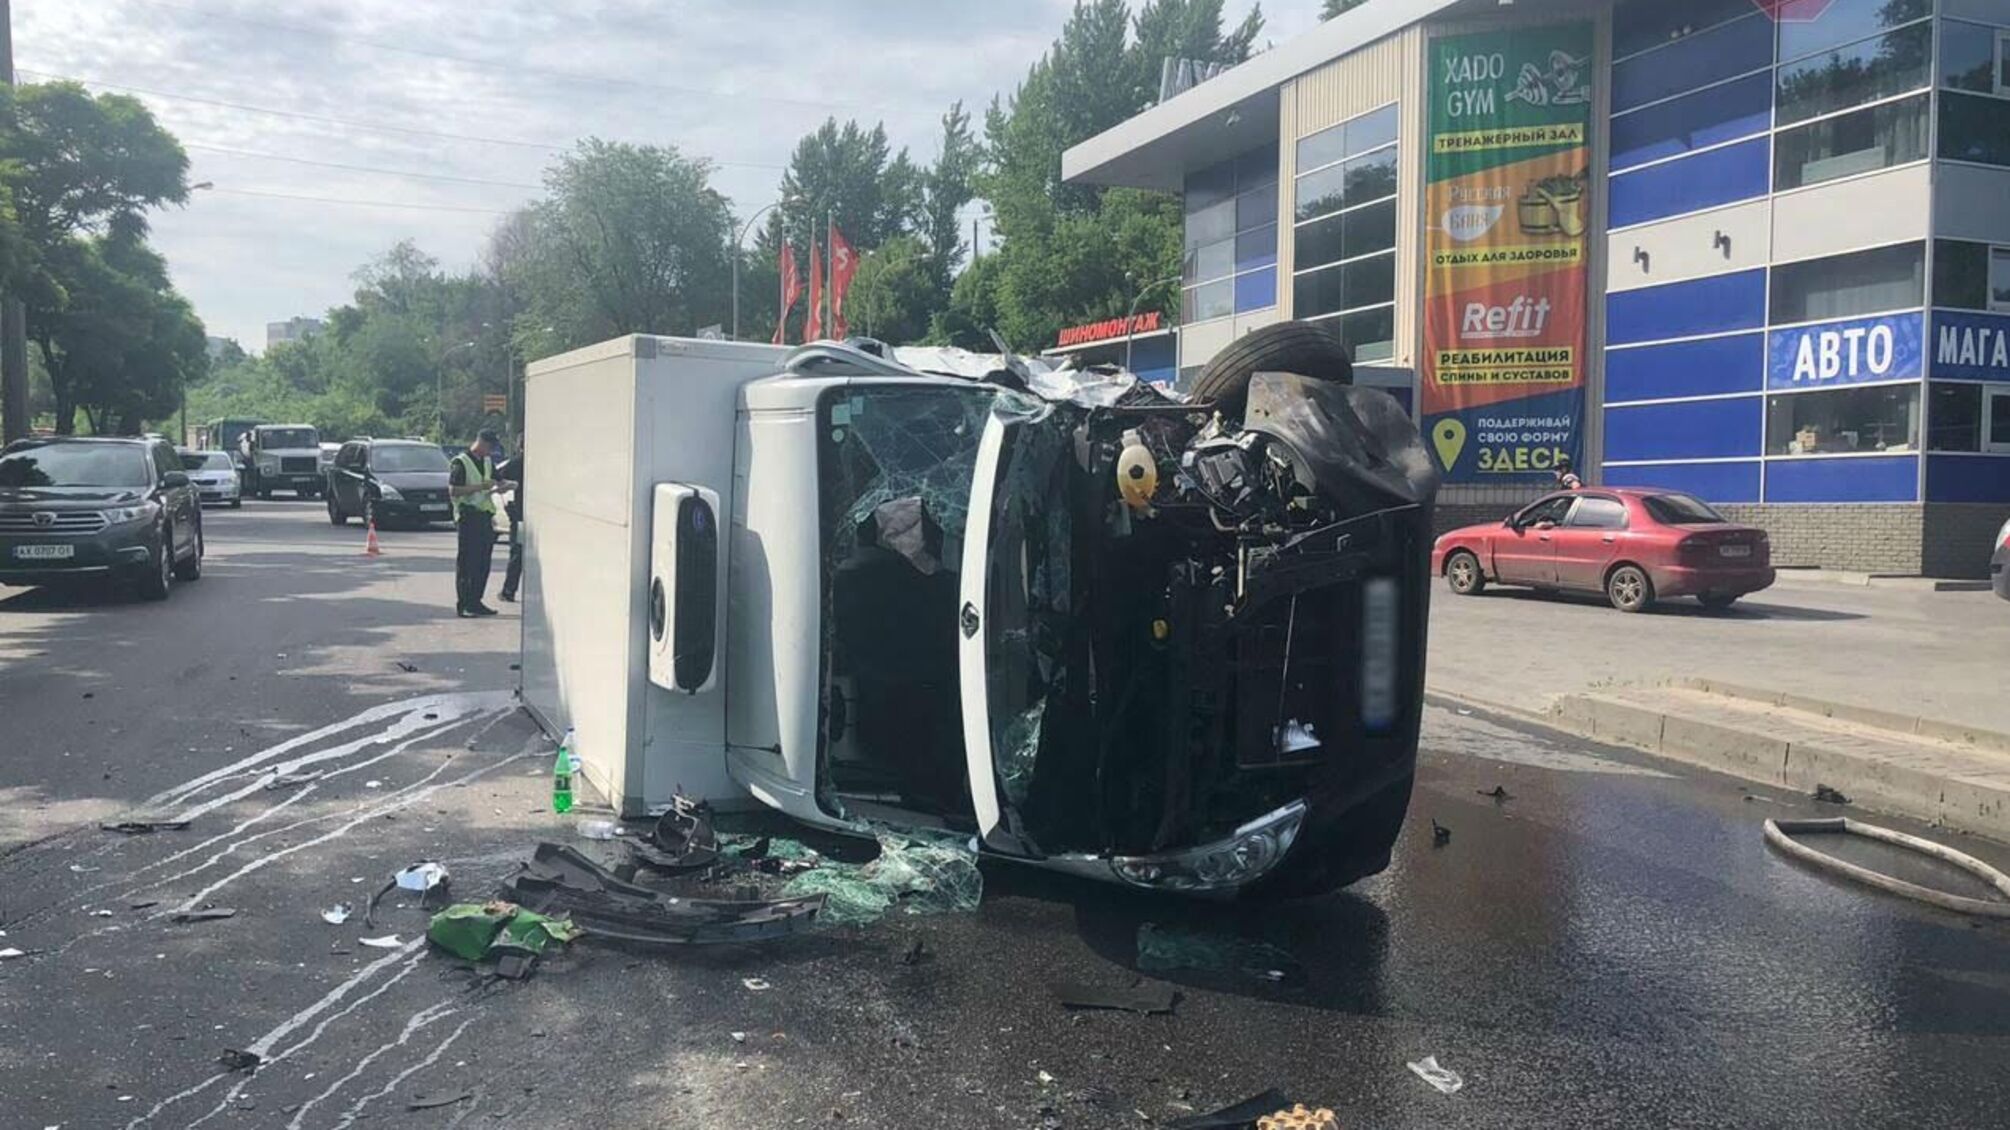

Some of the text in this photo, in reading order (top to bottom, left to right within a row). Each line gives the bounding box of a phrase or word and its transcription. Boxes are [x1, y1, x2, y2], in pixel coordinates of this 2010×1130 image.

[1444, 53, 1504, 84] XADO
[1447, 88, 1495, 117] GYM
[1439, 128, 1578, 149] ТРЕНАЖЕРНЫЙ ЗАЛ
[1436, 248, 1577, 265] ОТДЫХ ДЛЯ ЗДОРОВЬЯ
[1462, 295, 1551, 335] Refit
[1058, 311, 1160, 345] ШИНОМОНТАЖ
[1441, 350, 1569, 365] РЕАБИЛИТАЦИЯ
[1793, 324, 1893, 381] АВТО
[1937, 325, 2009, 368] МАГА
[1440, 370, 1569, 382] СПИНЫ И СУСТАВОВ
[1478, 416, 1570, 428] ПОДДЕРЖИВАЙ
[1478, 432, 1569, 443] СВОЮ ФОРМУ
[1478, 447, 1570, 472] ЗДЕСЬ
